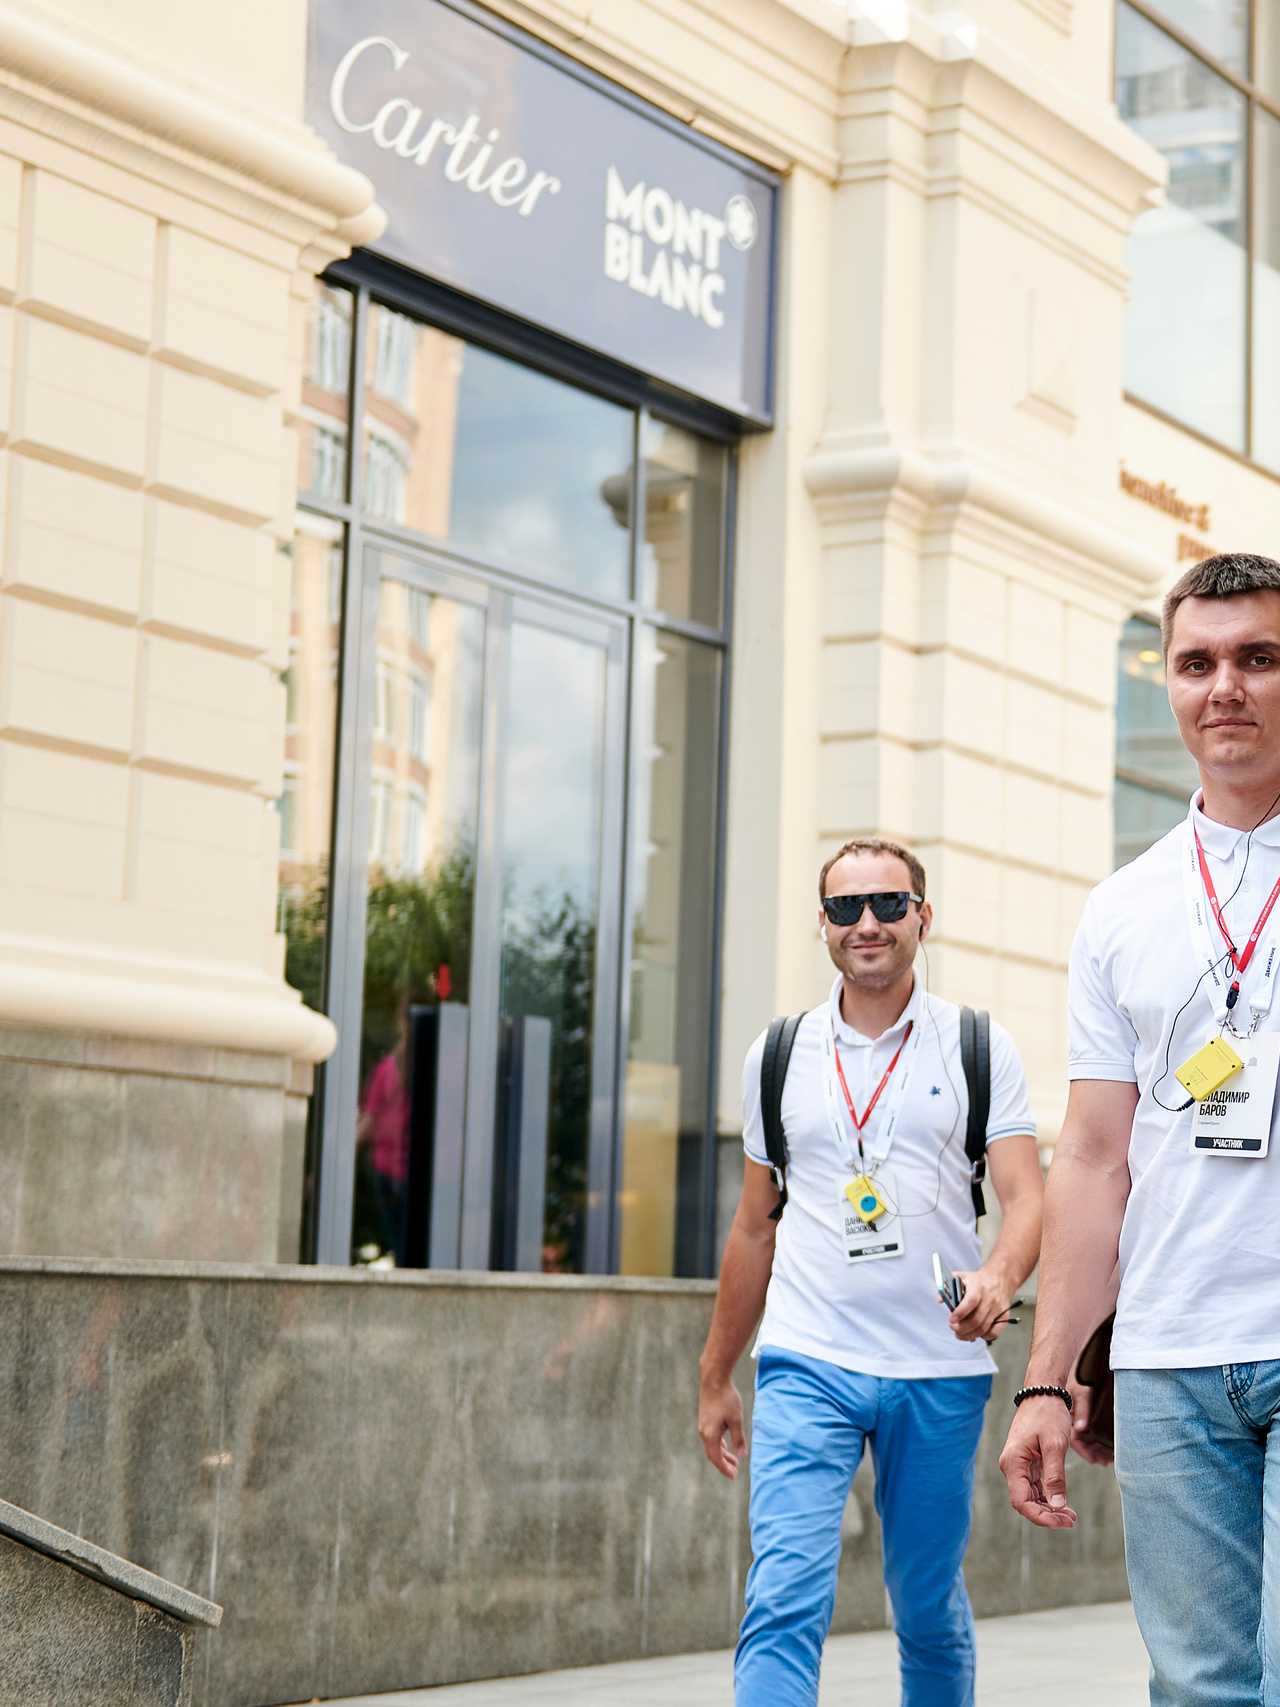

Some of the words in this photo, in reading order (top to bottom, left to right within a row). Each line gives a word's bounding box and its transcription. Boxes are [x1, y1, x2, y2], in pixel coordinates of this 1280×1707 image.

[330, 35, 561, 217] Cartier
[605, 164, 726, 271] MONT
[604, 221, 726, 329] BLANC
[1199, 1103, 1227, 1117] БАРОВ
[1203, 1090, 1250, 1104] ЛАДИМИР
[1212, 1138, 1244, 1149] УЧАСТНИК
